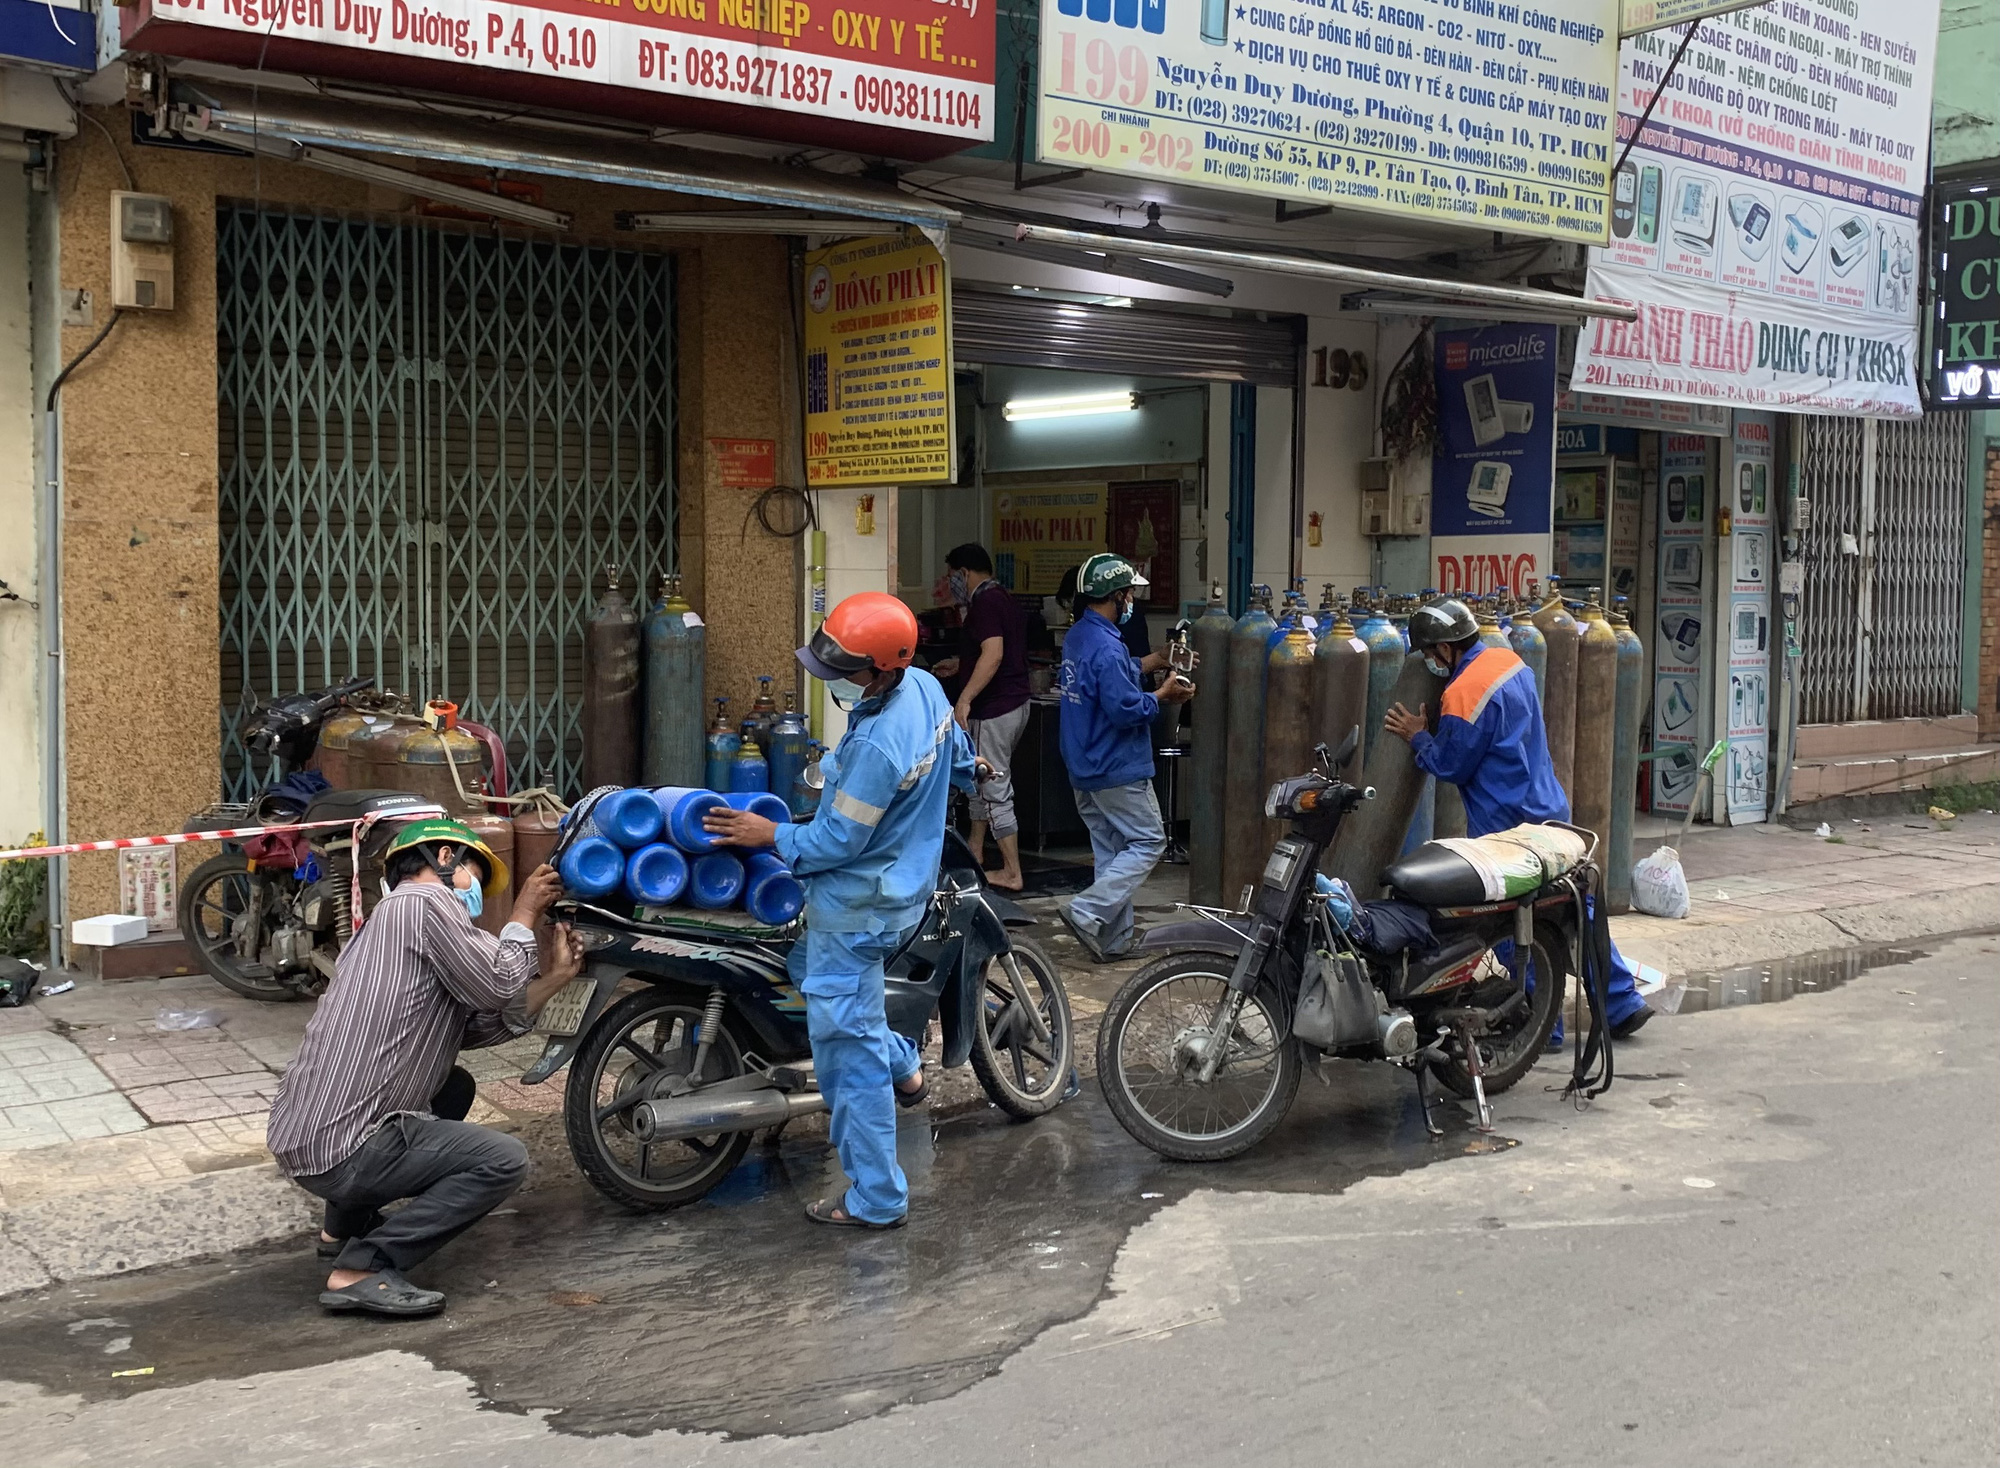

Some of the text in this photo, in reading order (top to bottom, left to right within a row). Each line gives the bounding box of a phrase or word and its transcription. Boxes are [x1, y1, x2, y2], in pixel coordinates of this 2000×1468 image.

[832, 9, 881, 51] OXY
[890, 19, 905, 55] Y
[915, 16, 947, 62] TẾ
[1378, 5, 1424, 32] ARGON
[1476, 28, 1505, 50] NITƠ
[1499, 3, 1604, 46] KHÍ CÔNG NGHIỆP
[1782, 2, 1810, 27] VIÊM
[1813, 12, 1850, 41] XOANG
[1860, 30, 1882, 52] HEN
[335, 0, 383, 43] Duy
[392, 6, 478, 59] Dương,
[487, 14, 533, 67] P.4,
[542, 22, 597, 71] Q.10
[638, 39, 677, 82] ĐT:
[686, 47, 832, 105] 083.9271837
[855, 74, 981, 129] 0903811104
[1055, 31, 1149, 106] 199
[1250, 6, 1285, 31] CUNG
[1289, 13, 1314, 37] CẤP
[1375, 35, 1394, 56] GIÓ
[1397, 39, 1413, 60] ĐÁ
[1424, 45, 1446, 68] ĐÈN
[1449, 51, 1472, 74] HÀN
[1483, 58, 1505, 80] ĐÈN
[1538, 72, 1559, 96] PHỤ
[1562, 77, 1585, 100] KIỆN
[1588, 82, 1609, 103] HÀN
[1789, 30, 1824, 59] NGOẠI
[1834, 46, 1858, 69] MÁY
[1248, 39, 1607, 131] DỊCH VỤ CHO THUÊ OXY Y TẾ & CUNG CẤP MÁY TẠO OXY
[1634, 32, 1665, 57] MÁY
[1697, 52, 1726, 77] ĐÀM
[1737, 64, 1765, 91] NỆM
[1811, 90, 1838, 113] LOÉT
[1735, 37, 1771, 66] CHÂM
[1866, 83, 1898, 110] NGOẠI
[1101, 110, 1117, 122] CHI
[1156, 56, 1237, 91] Nguyễn
[1244, 73, 1285, 105] Duy
[1291, 82, 1359, 119] Dương,
[1365, 97, 1434, 134] Phường
[1458, 117, 1504, 146] Quận
[1512, 127, 1534, 152] 10,
[1539, 132, 1566, 155] TP.
[1571, 139, 1608, 162] HCM
[1632, 59, 1663, 84] MÁY
[1747, 96, 1771, 118] OXY
[1773, 104, 1811, 131] TRONG
[1814, 115, 1840, 139] MÁU
[1849, 127, 1873, 149] MÁY
[1875, 135, 1894, 157] TẠO
[1896, 141, 1915, 162] OXY
[1658, 95, 1669, 115] Y
[1672, 100, 1713, 129] KHOA
[1052, 115, 1194, 172] 200 202
[1187, 96, 1605, 188] (028) 39270624 (028) 39270199 0909816599 0909916599
[1204, 130, 1260, 162] Đường
[1264, 140, 1286, 162] Số
[1288, 145, 1312, 171] 55,
[1316, 151, 1342, 171] KP
[1364, 159, 1380, 178] P.
[1385, 162, 1415, 184] Tân
[1455, 175, 1471, 196] Q.
[1475, 178, 1508, 200] Bình
[1548, 190, 1570, 210] TP.
[1574, 195, 1603, 216] HCM
[1224, 161, 1250, 183] (028)
[1308, 176, 1332, 195] (028)
[1386, 188, 1410, 204] FAX:
[1412, 192, 1434, 210] (028)
[887, 257, 938, 302] PHÁT
[1311, 346, 1369, 391] 199
[1470, 334, 1546, 361] microlife
[1757, 321, 1811, 382] DỤNG
[1815, 331, 1840, 388] CỤ
[1843, 335, 1855, 380] Y
[1856, 337, 1909, 386] KHOA
[1585, 363, 1612, 386] 201
[1615, 369, 1660, 390] NGUYỄN
[808, 431, 828, 457] 199
[1738, 422, 1770, 442] KHOA
[1049, 509, 1097, 541] PHÁT
[1103, 563, 1127, 580] Grab
[377, 797, 417, 807] HONDA
[1472, 905, 1499, 913] HONDA
[922, 930, 962, 941] HODA
